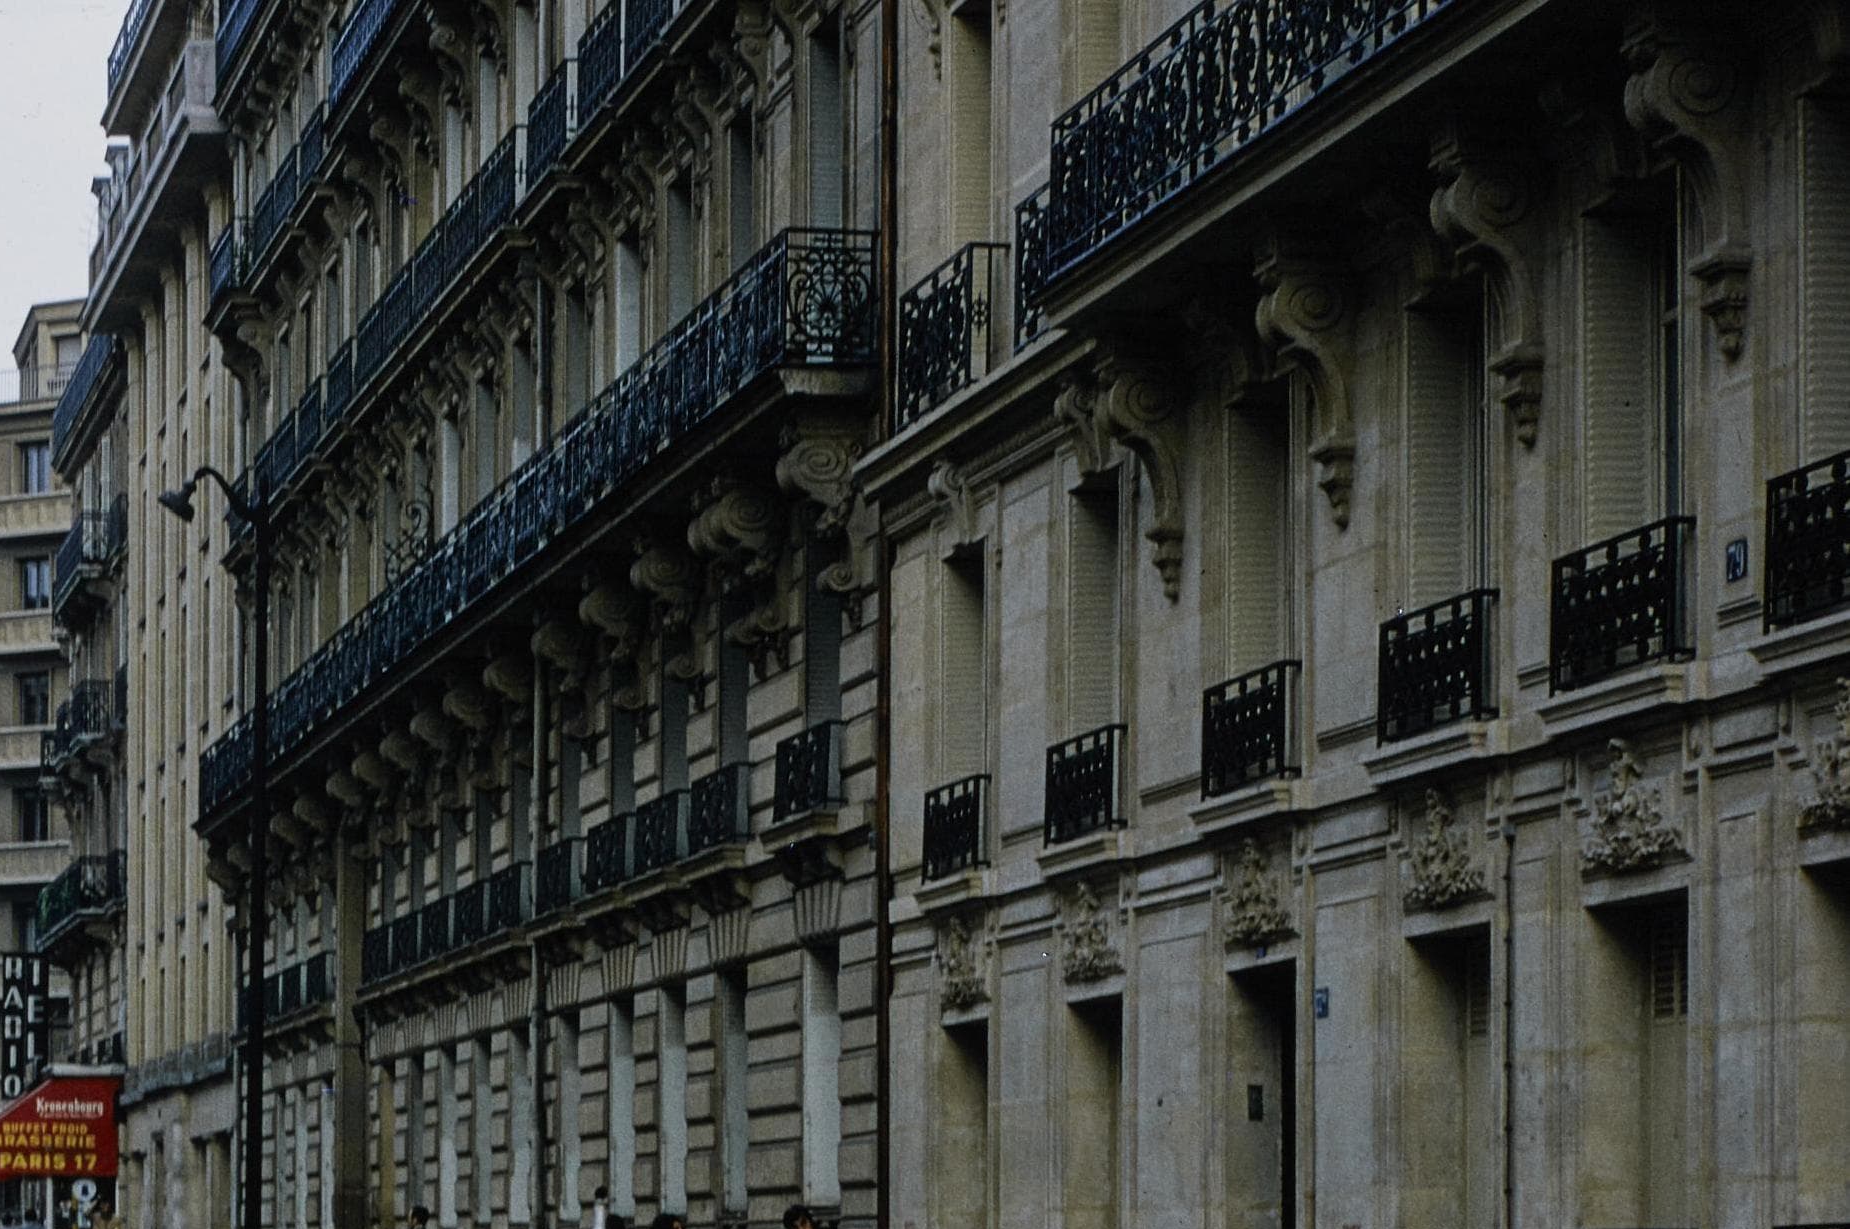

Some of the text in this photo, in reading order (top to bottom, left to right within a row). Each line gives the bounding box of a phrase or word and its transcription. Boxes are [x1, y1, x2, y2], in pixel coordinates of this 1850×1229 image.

[1727, 543, 1744, 579] 79
[3, 956, 23, 1097] RADIO
[36, 1096, 104, 1116] Kronenbourg
[2, 1121, 88, 1134] BUFFET FROID
[0, 1152, 66, 1170] PARIS
[74, 1153, 98, 1171] 17
